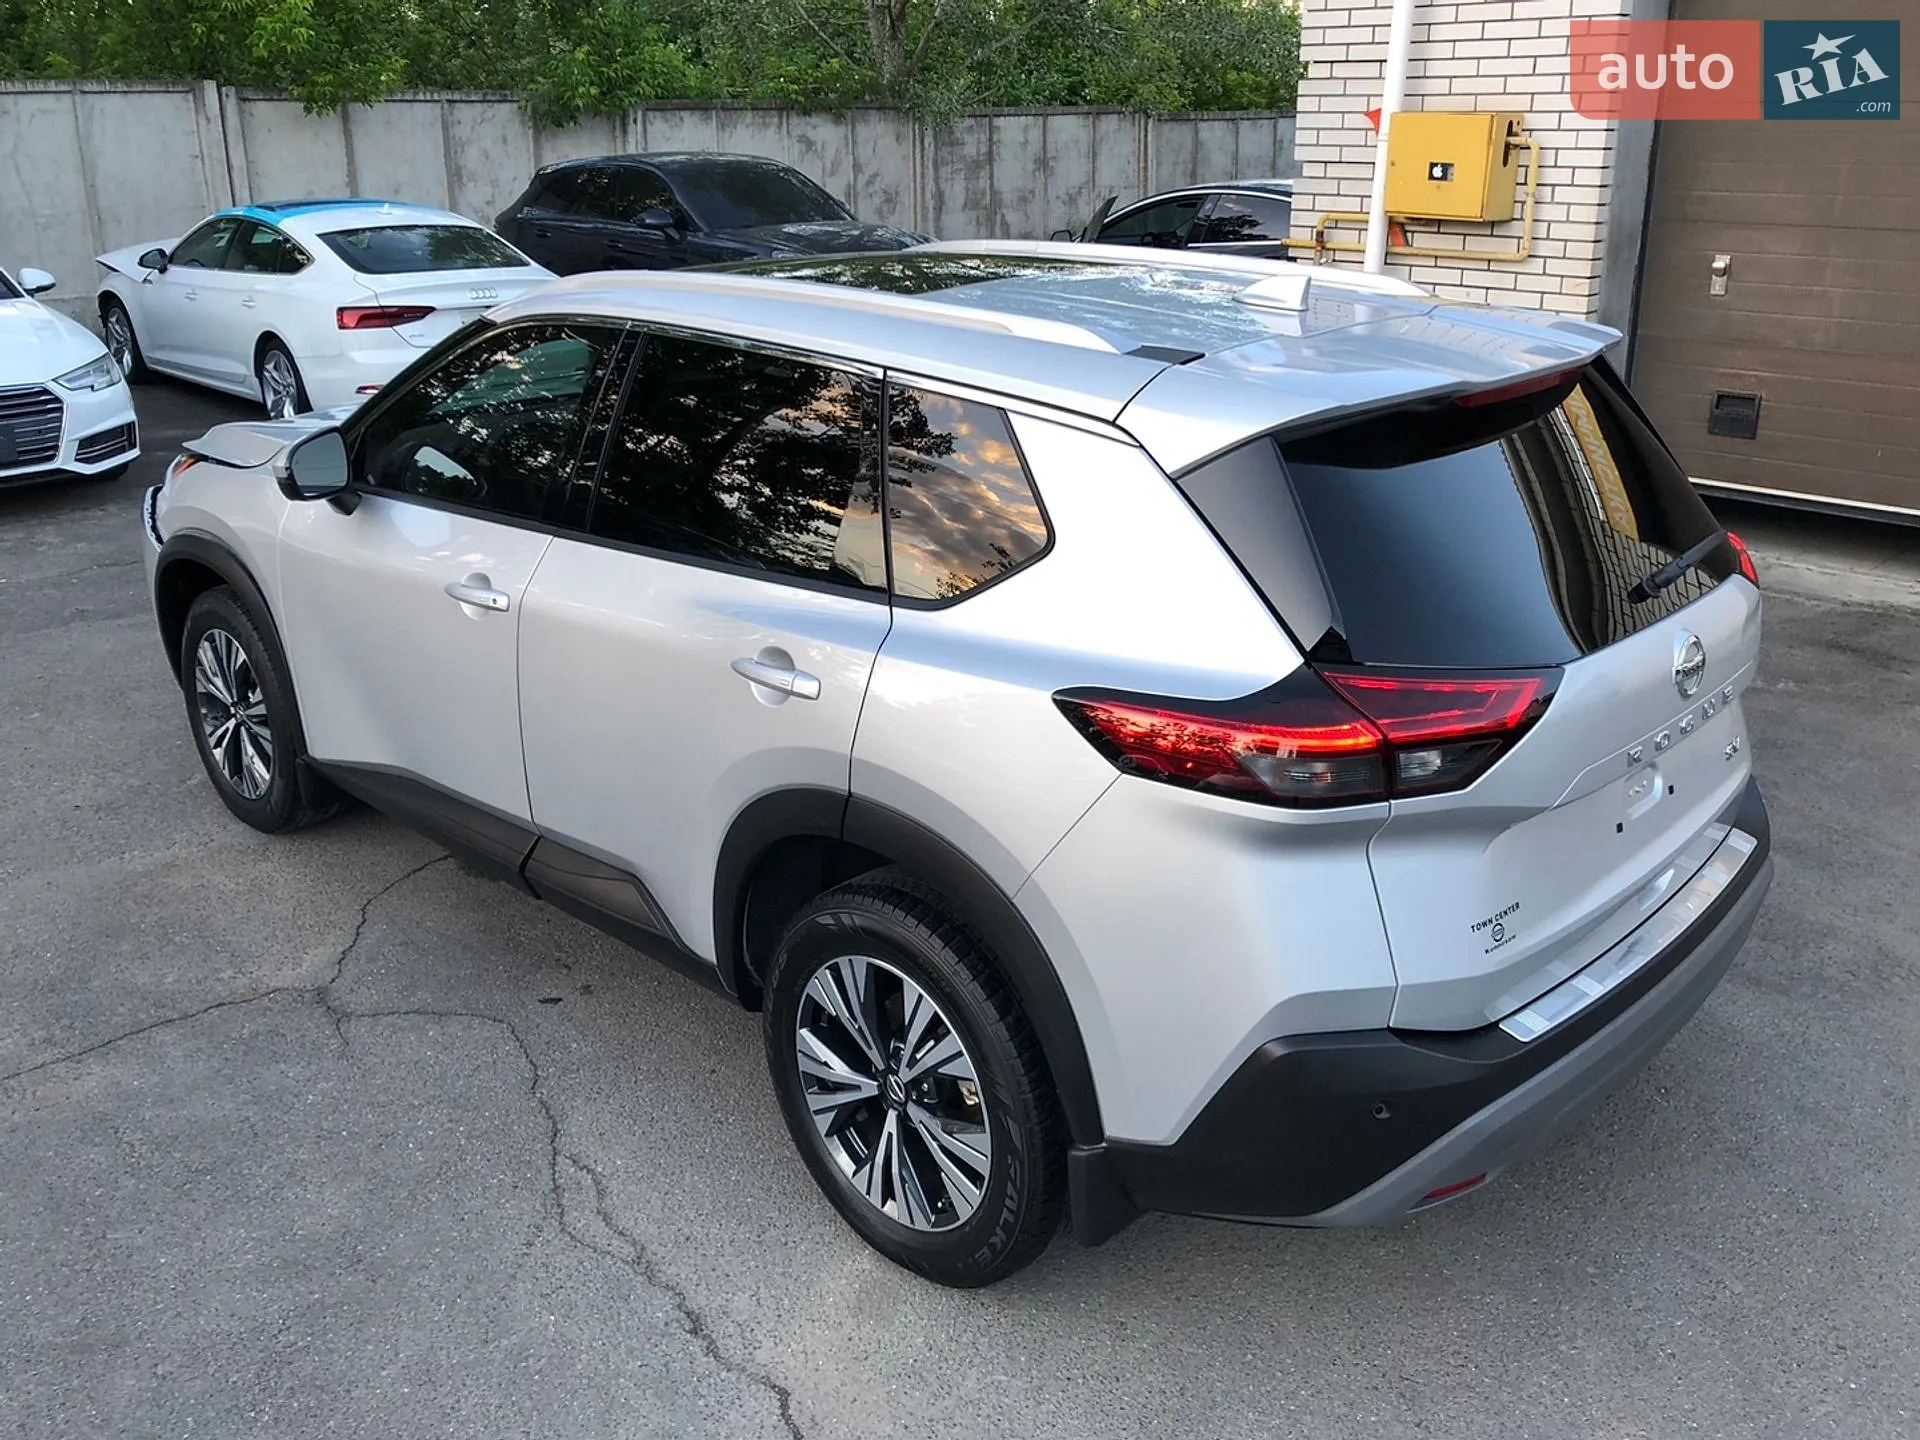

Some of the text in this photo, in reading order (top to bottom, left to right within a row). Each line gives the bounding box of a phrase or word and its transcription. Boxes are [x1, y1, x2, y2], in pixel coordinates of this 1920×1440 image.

[1627, 686, 1733, 767] ROGUE
[1470, 901, 1520, 933] TOWN CENTER
